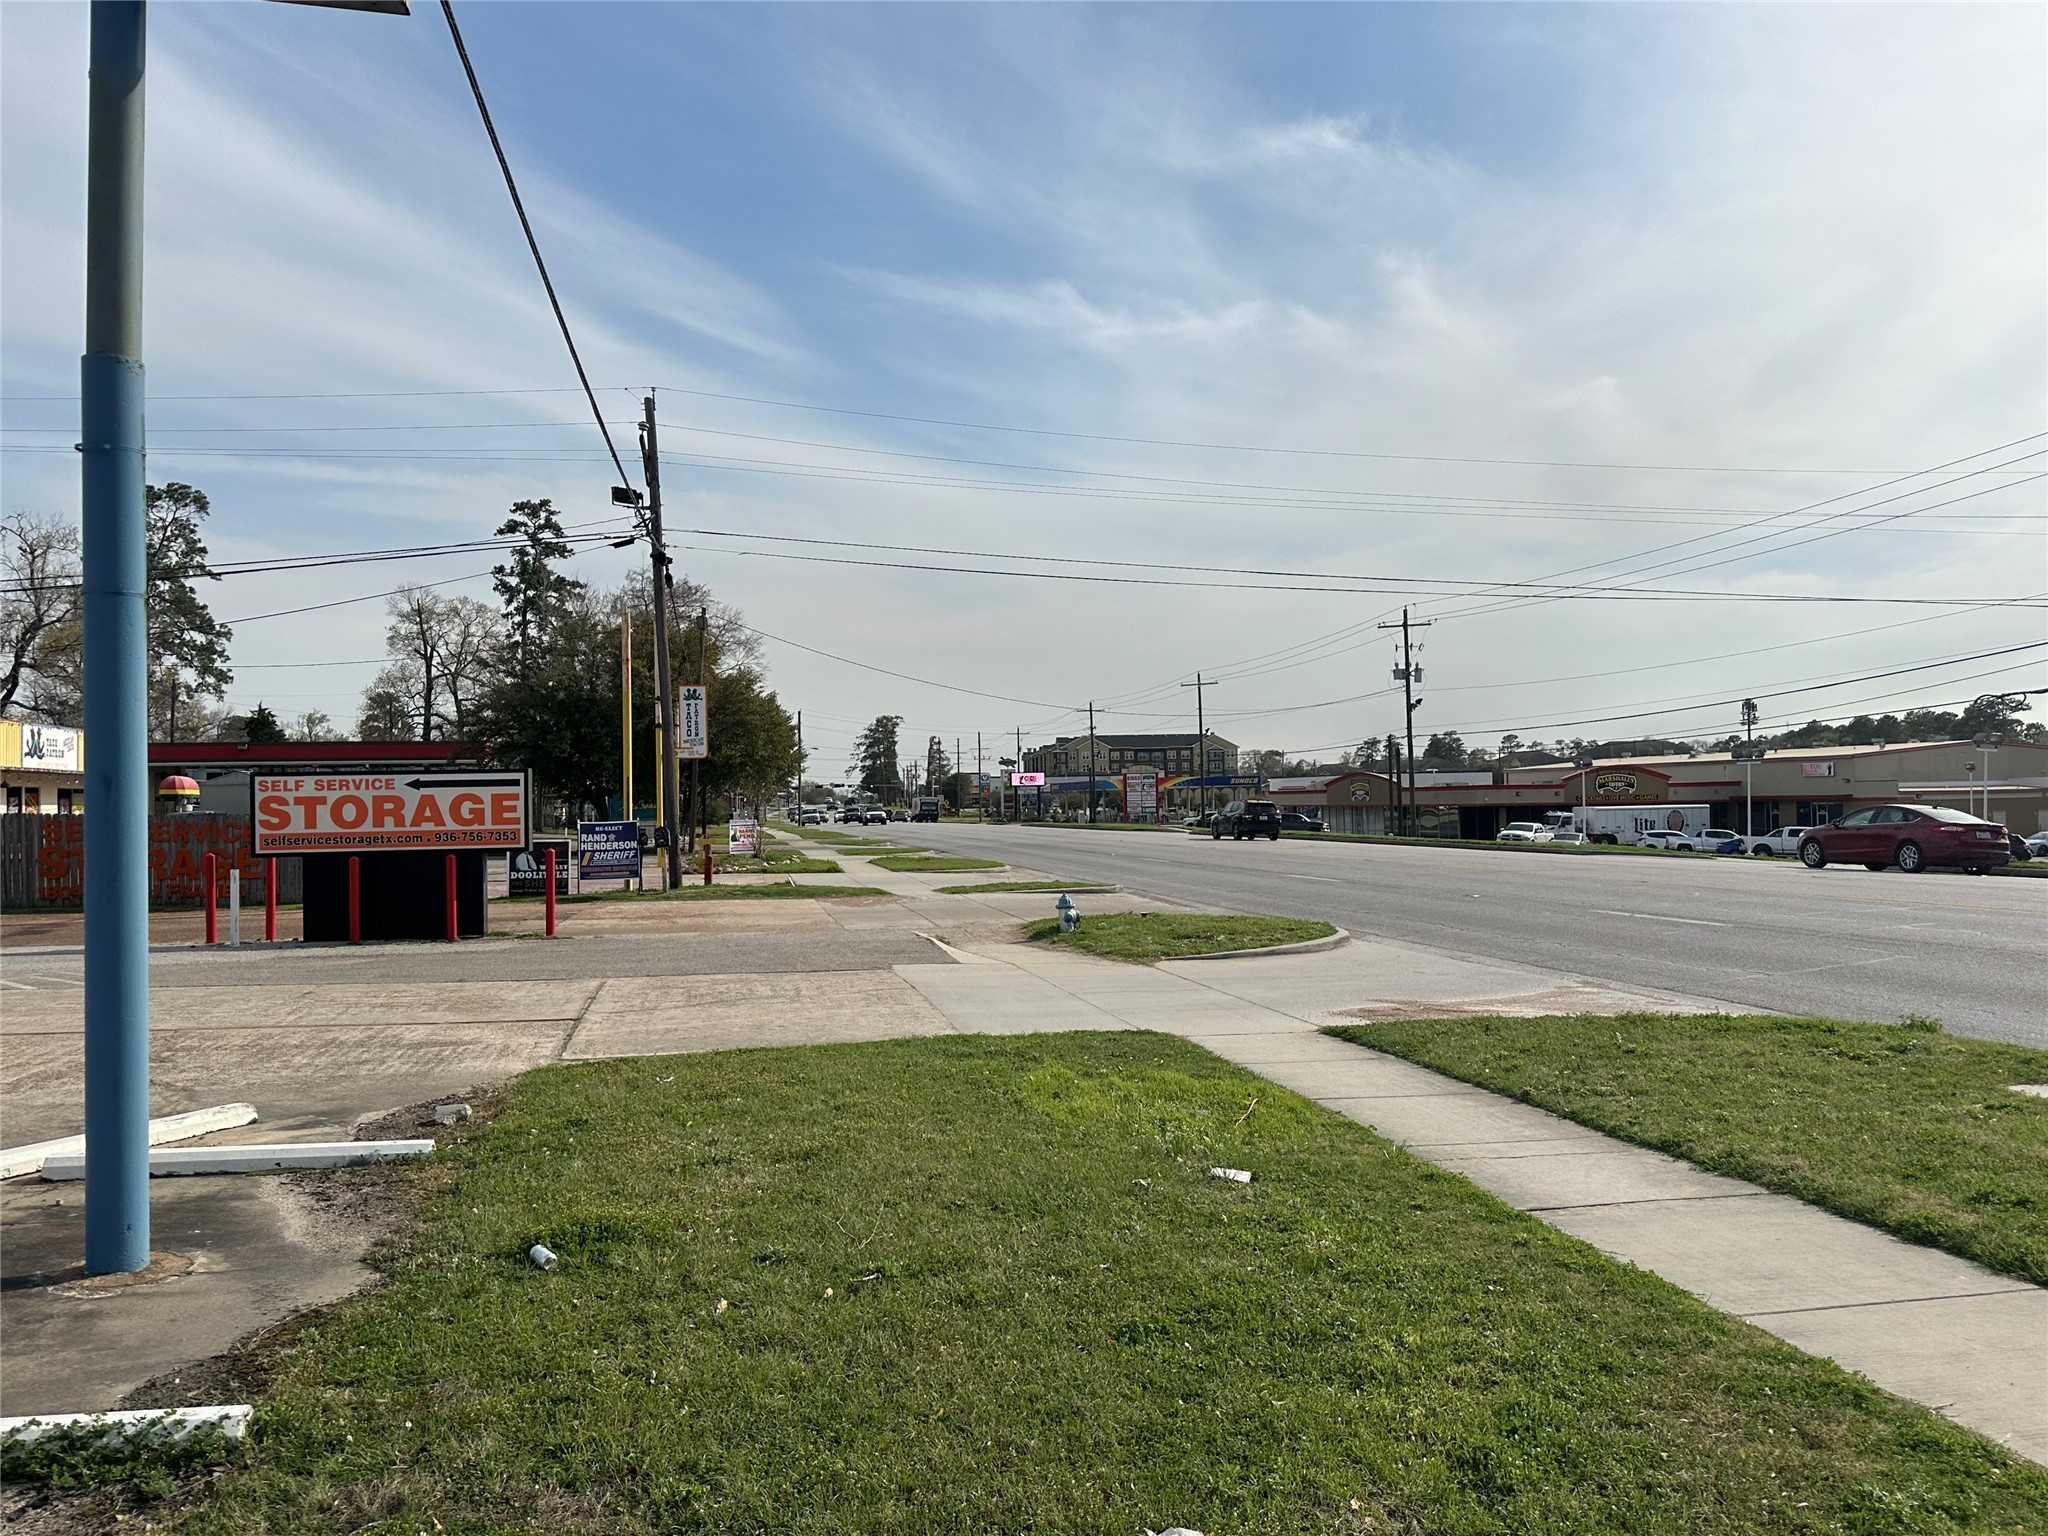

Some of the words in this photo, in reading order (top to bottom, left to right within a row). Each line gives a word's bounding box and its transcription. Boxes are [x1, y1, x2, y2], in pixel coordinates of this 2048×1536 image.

[258, 780, 304, 792] SELF
[314, 778, 396, 791] SERVICE
[258, 793, 520, 831] STORAGE
[42, 819, 84, 843] SE
[150, 820, 250, 844] ERVICE
[1634, 818, 1656, 836] Lite
[263, 835, 423, 847] selfservicestoragetx.com
[434, 831, 517, 843] 936-756-7353
[581, 833, 607, 842] RAND
[580, 840, 638, 851] HENDERSON
[593, 850, 636, 860] SHERIFF
[38, 846, 261, 881] SRAGE
[510, 871, 568, 879] DOOLILE
[524, 879, 567, 888] SHEFF
[167, 884, 248, 898] FRAIER
